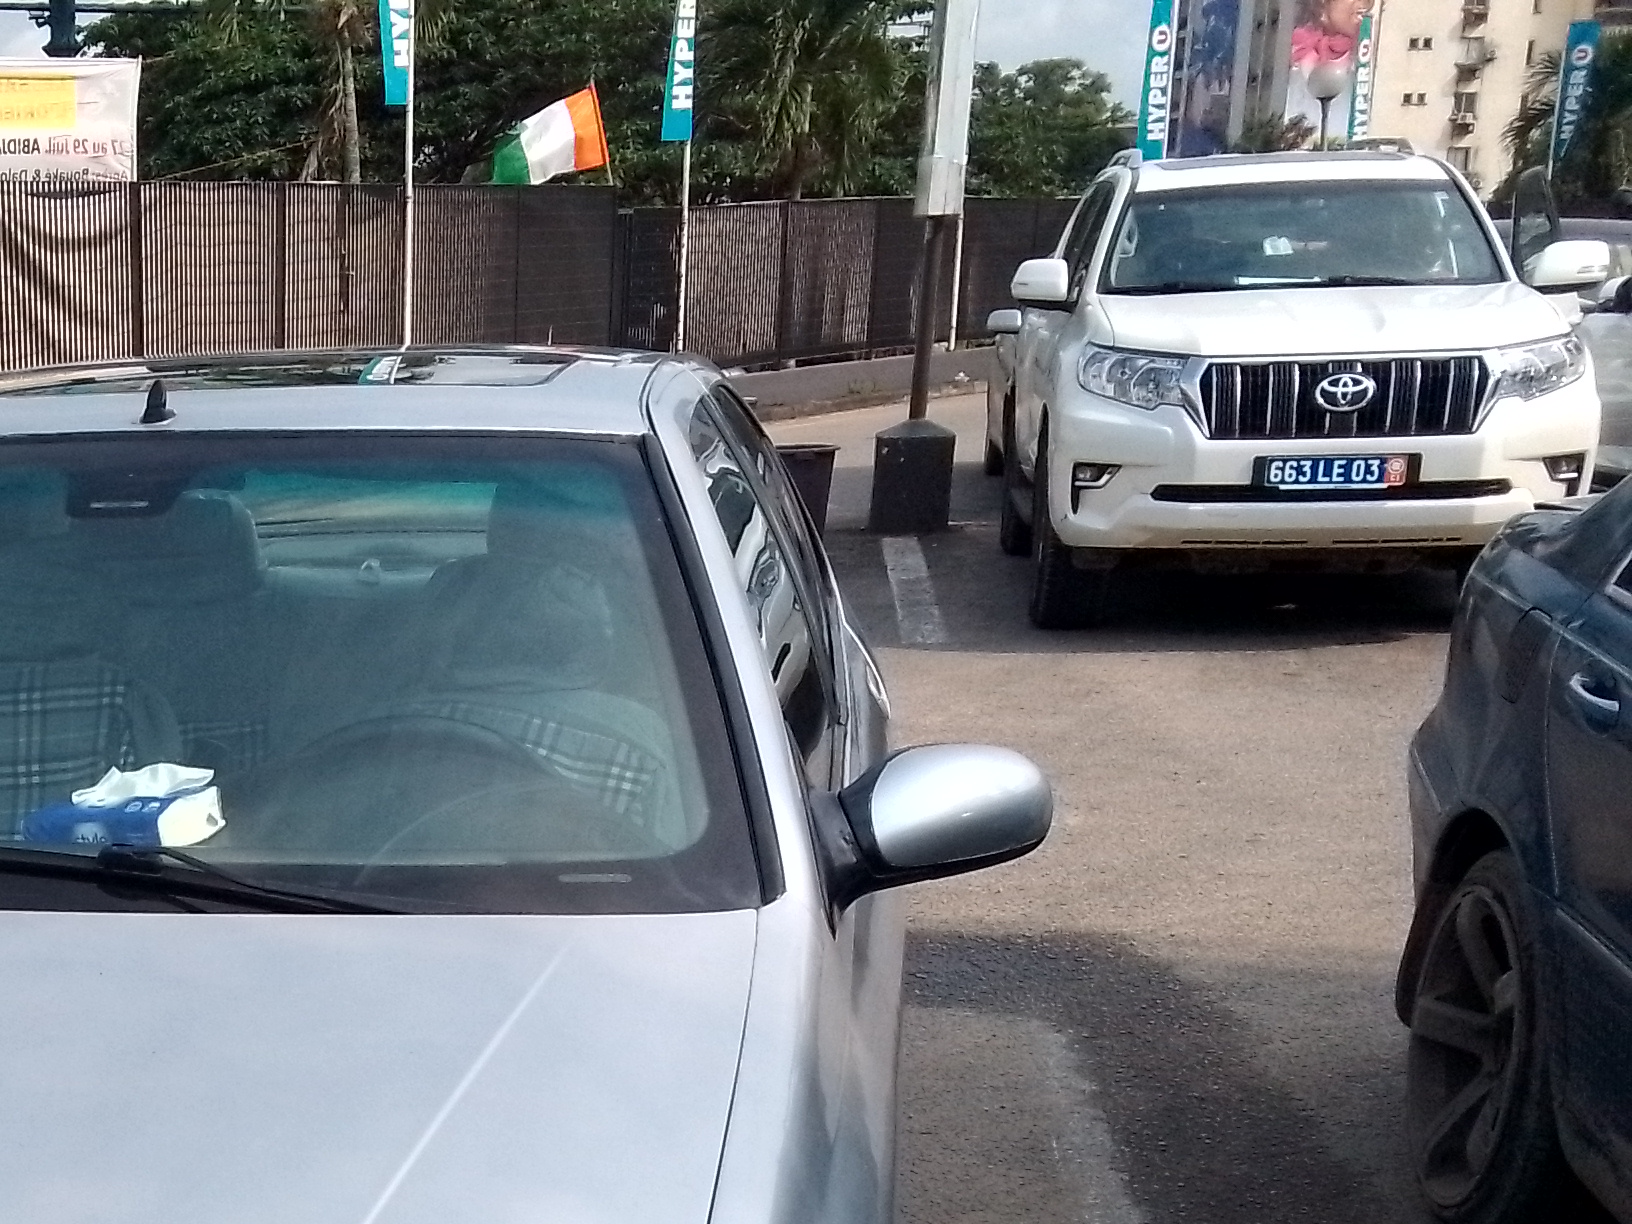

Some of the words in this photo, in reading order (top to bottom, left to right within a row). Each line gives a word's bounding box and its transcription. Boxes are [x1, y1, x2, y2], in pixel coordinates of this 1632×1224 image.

[671, 0, 696, 109] HYPER
[1146, 55, 1170, 141] HYPER
[1352, 66, 1370, 140] HYPER
[1560, 68, 1588, 140] HYPER
[1269, 460, 1312, 483] 663
[1316, 461, 1346, 483] LE
[1350, 459, 1381, 482] 03
